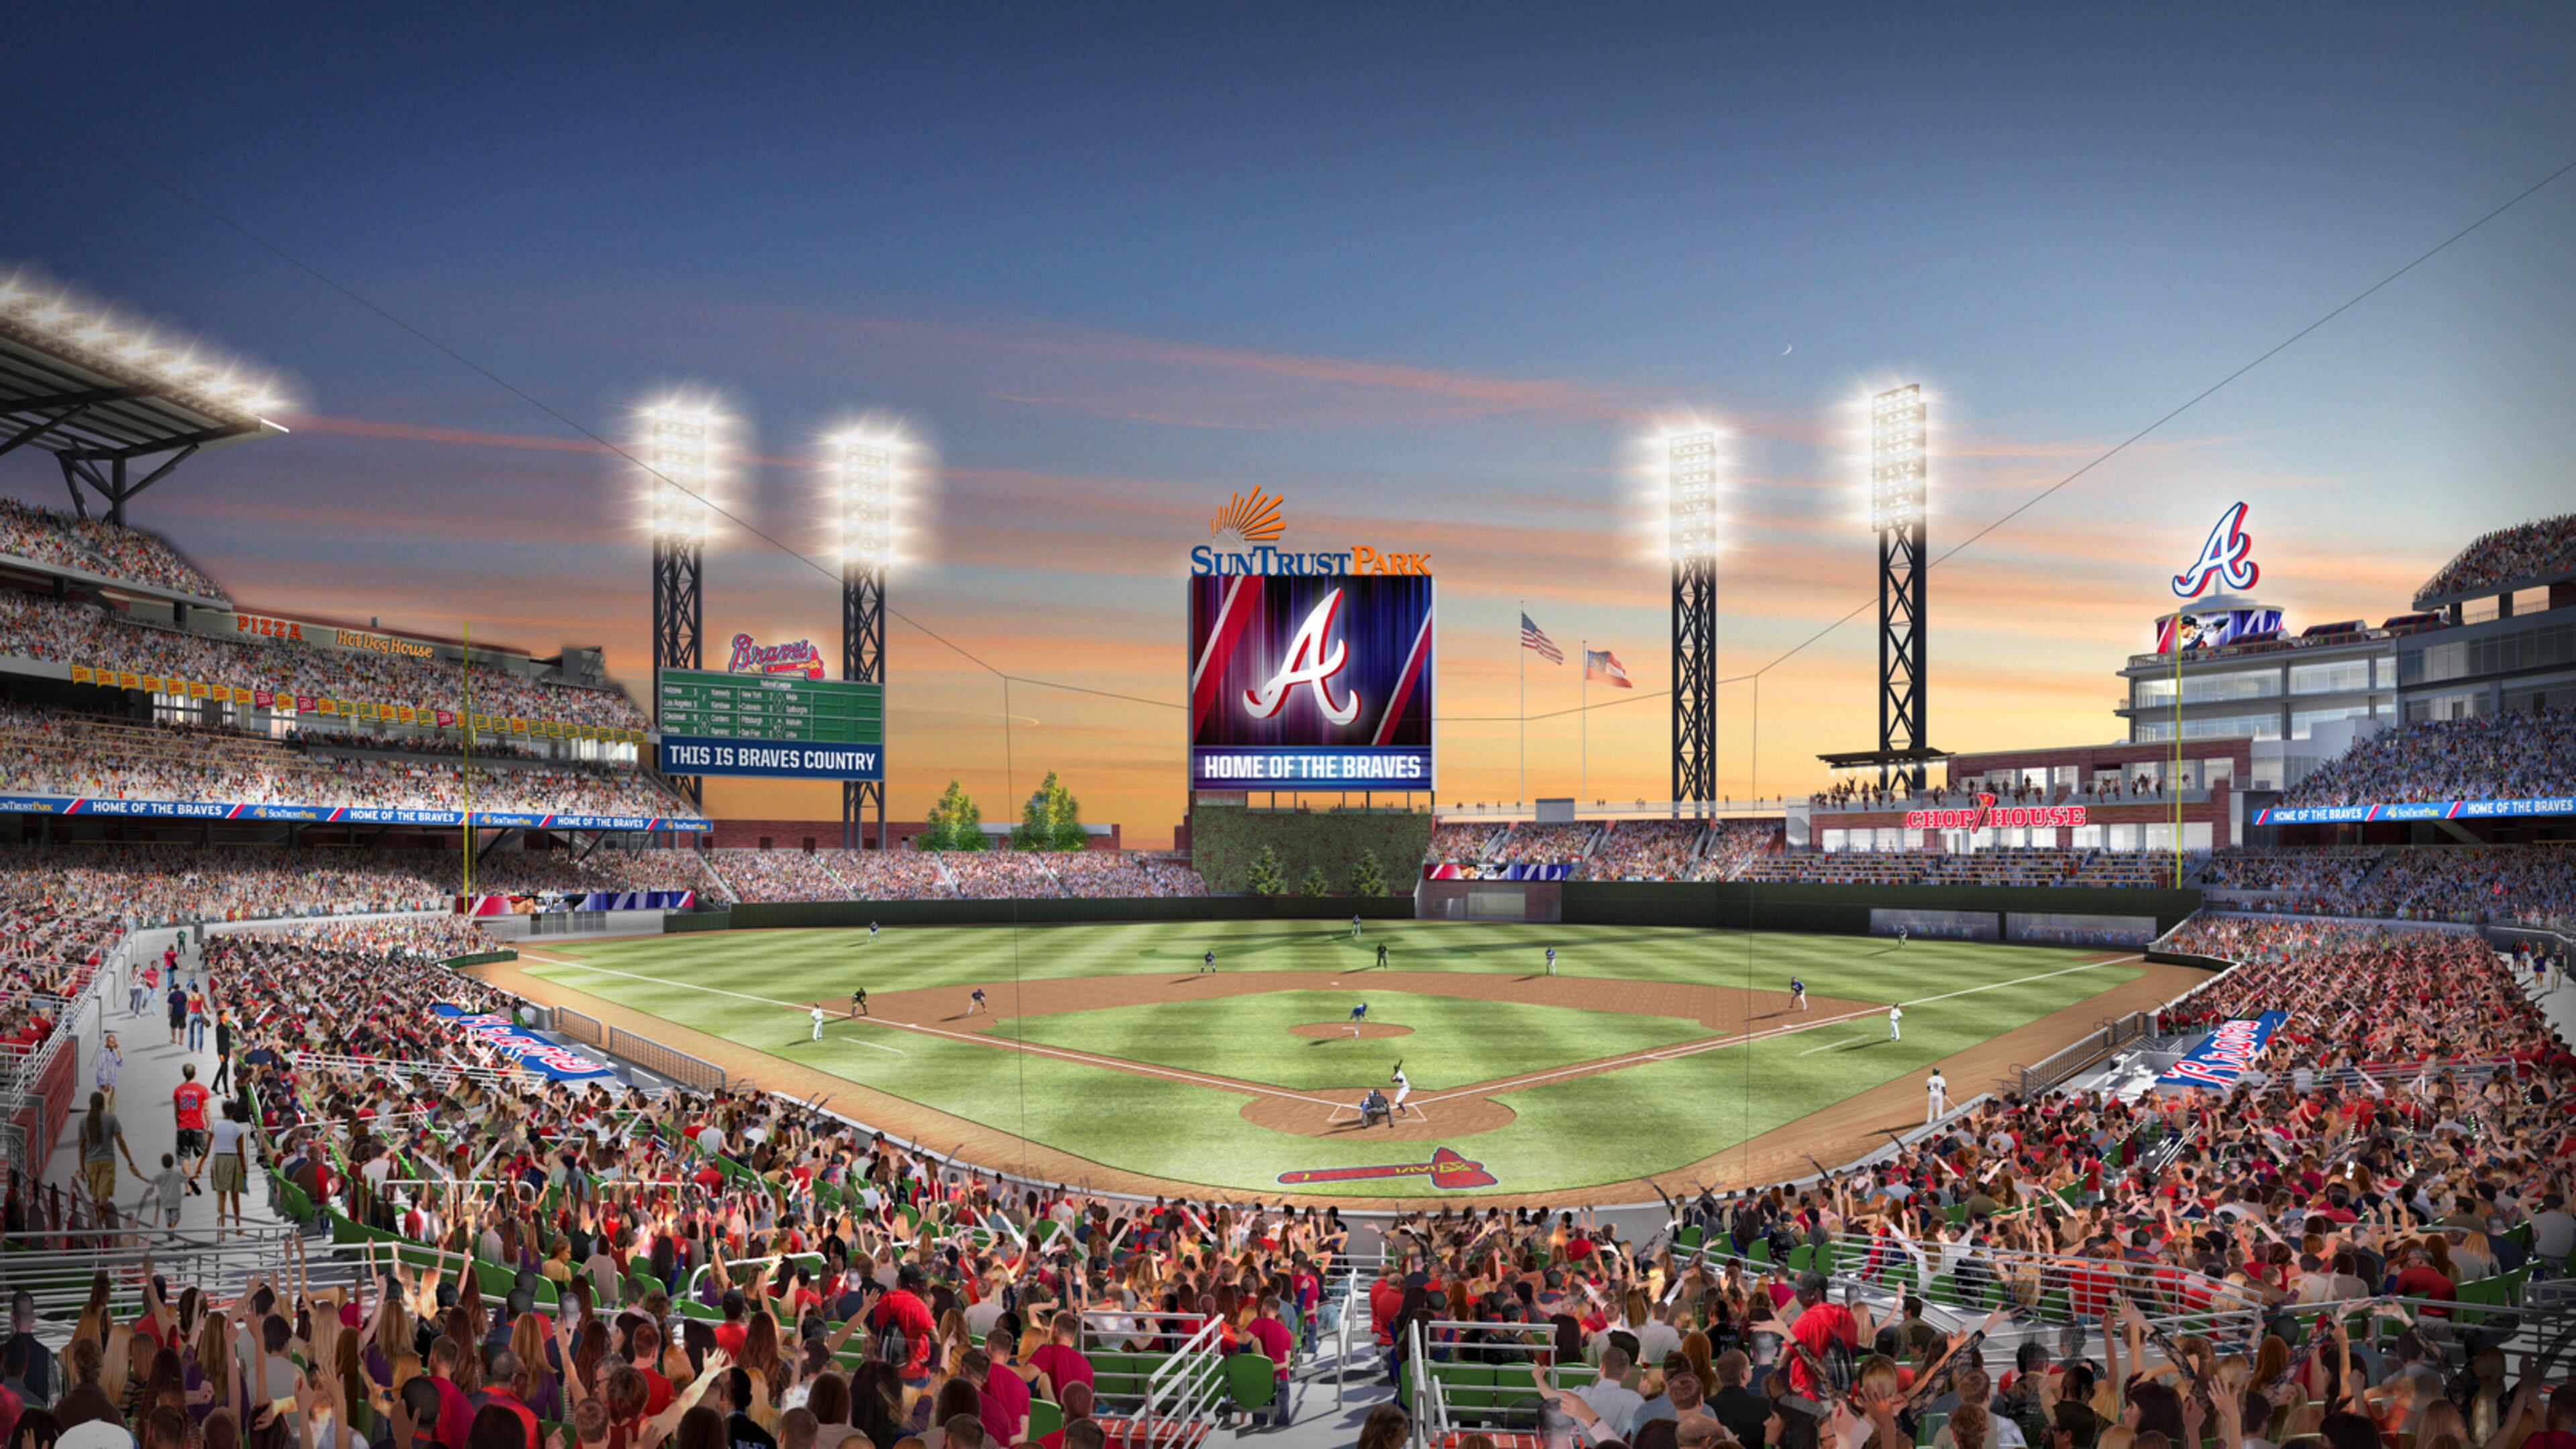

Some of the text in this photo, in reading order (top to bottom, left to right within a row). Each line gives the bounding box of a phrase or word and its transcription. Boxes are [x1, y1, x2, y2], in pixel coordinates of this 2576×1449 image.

[2171, 500, 2259, 598] A
[237, 614, 302, 640] PIZZA
[337, 629, 434, 658] Hot Dog House
[729, 633, 809, 673] Braves
[1242, 586, 1362, 725] A
[669, 745, 875, 771] THIS IS BRAVES COUNTRY
[1205, 755, 1421, 778] HOME OF THE BRAVES
[93, 802, 222, 816] HOME OF THE BRAVES
[350, 810, 455, 822] HOME OF THE BRAVES
[1907, 806, 2086, 829] CHOP HOUSE
[2273, 807, 2362, 822] HOME OF THE BRAVES
[2467, 800, 2574, 814] HOME OF THE BRAVES
[557, 817, 643, 828] HOME OF THE BRAVES
[180, 1096, 197, 1110] 24
